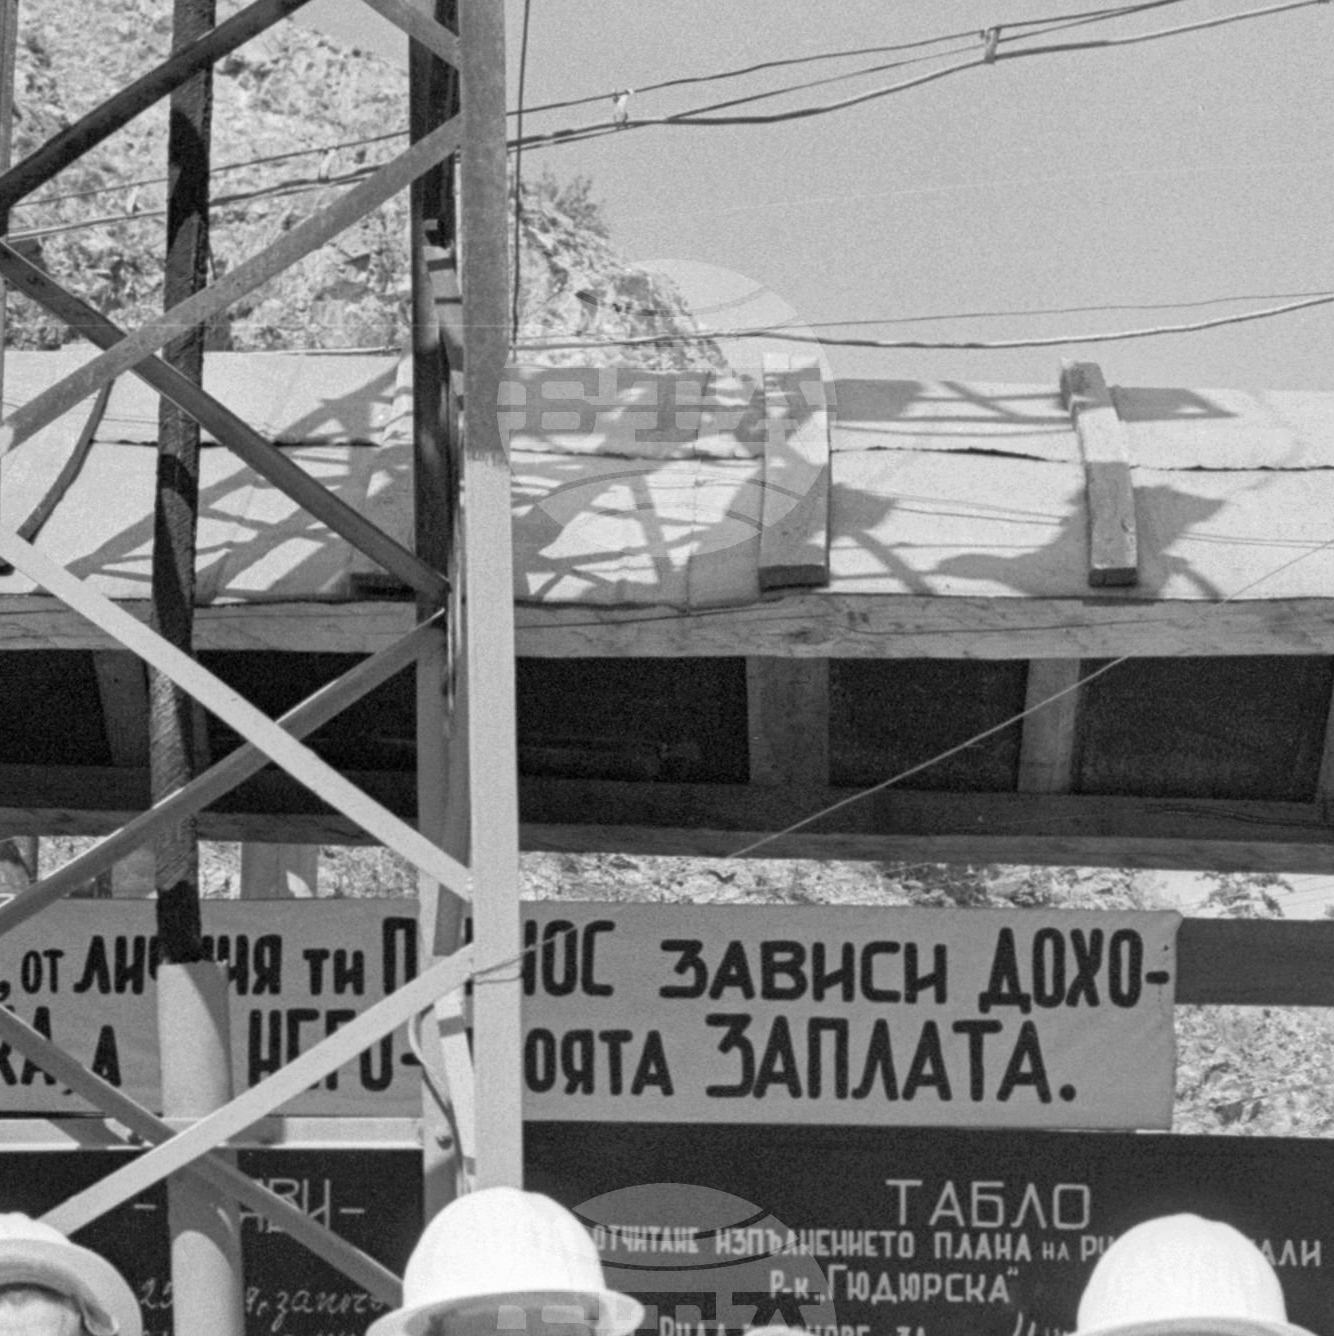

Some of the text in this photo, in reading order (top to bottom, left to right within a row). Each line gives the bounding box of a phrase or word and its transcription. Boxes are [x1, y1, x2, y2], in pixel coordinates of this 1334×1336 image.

[73, 934, 282, 995] ЛИИЯ
[382, 916, 616, 997] ПОС
[659, 939, 948, 1005] ЗАВИСИ
[978, 926, 1170, 1014] ДОХО-
[464, 1027, 675, 1097] ОЯТА
[705, 1013, 1078, 1104] ЗАПЛАТА.
[885, 1178, 1091, 1230] ТАБЛО
[714, 1227, 916, 1259] ИЗПЪЛНЕНИЕТО
[933, 1230, 1033, 1262] ПЛАНА
